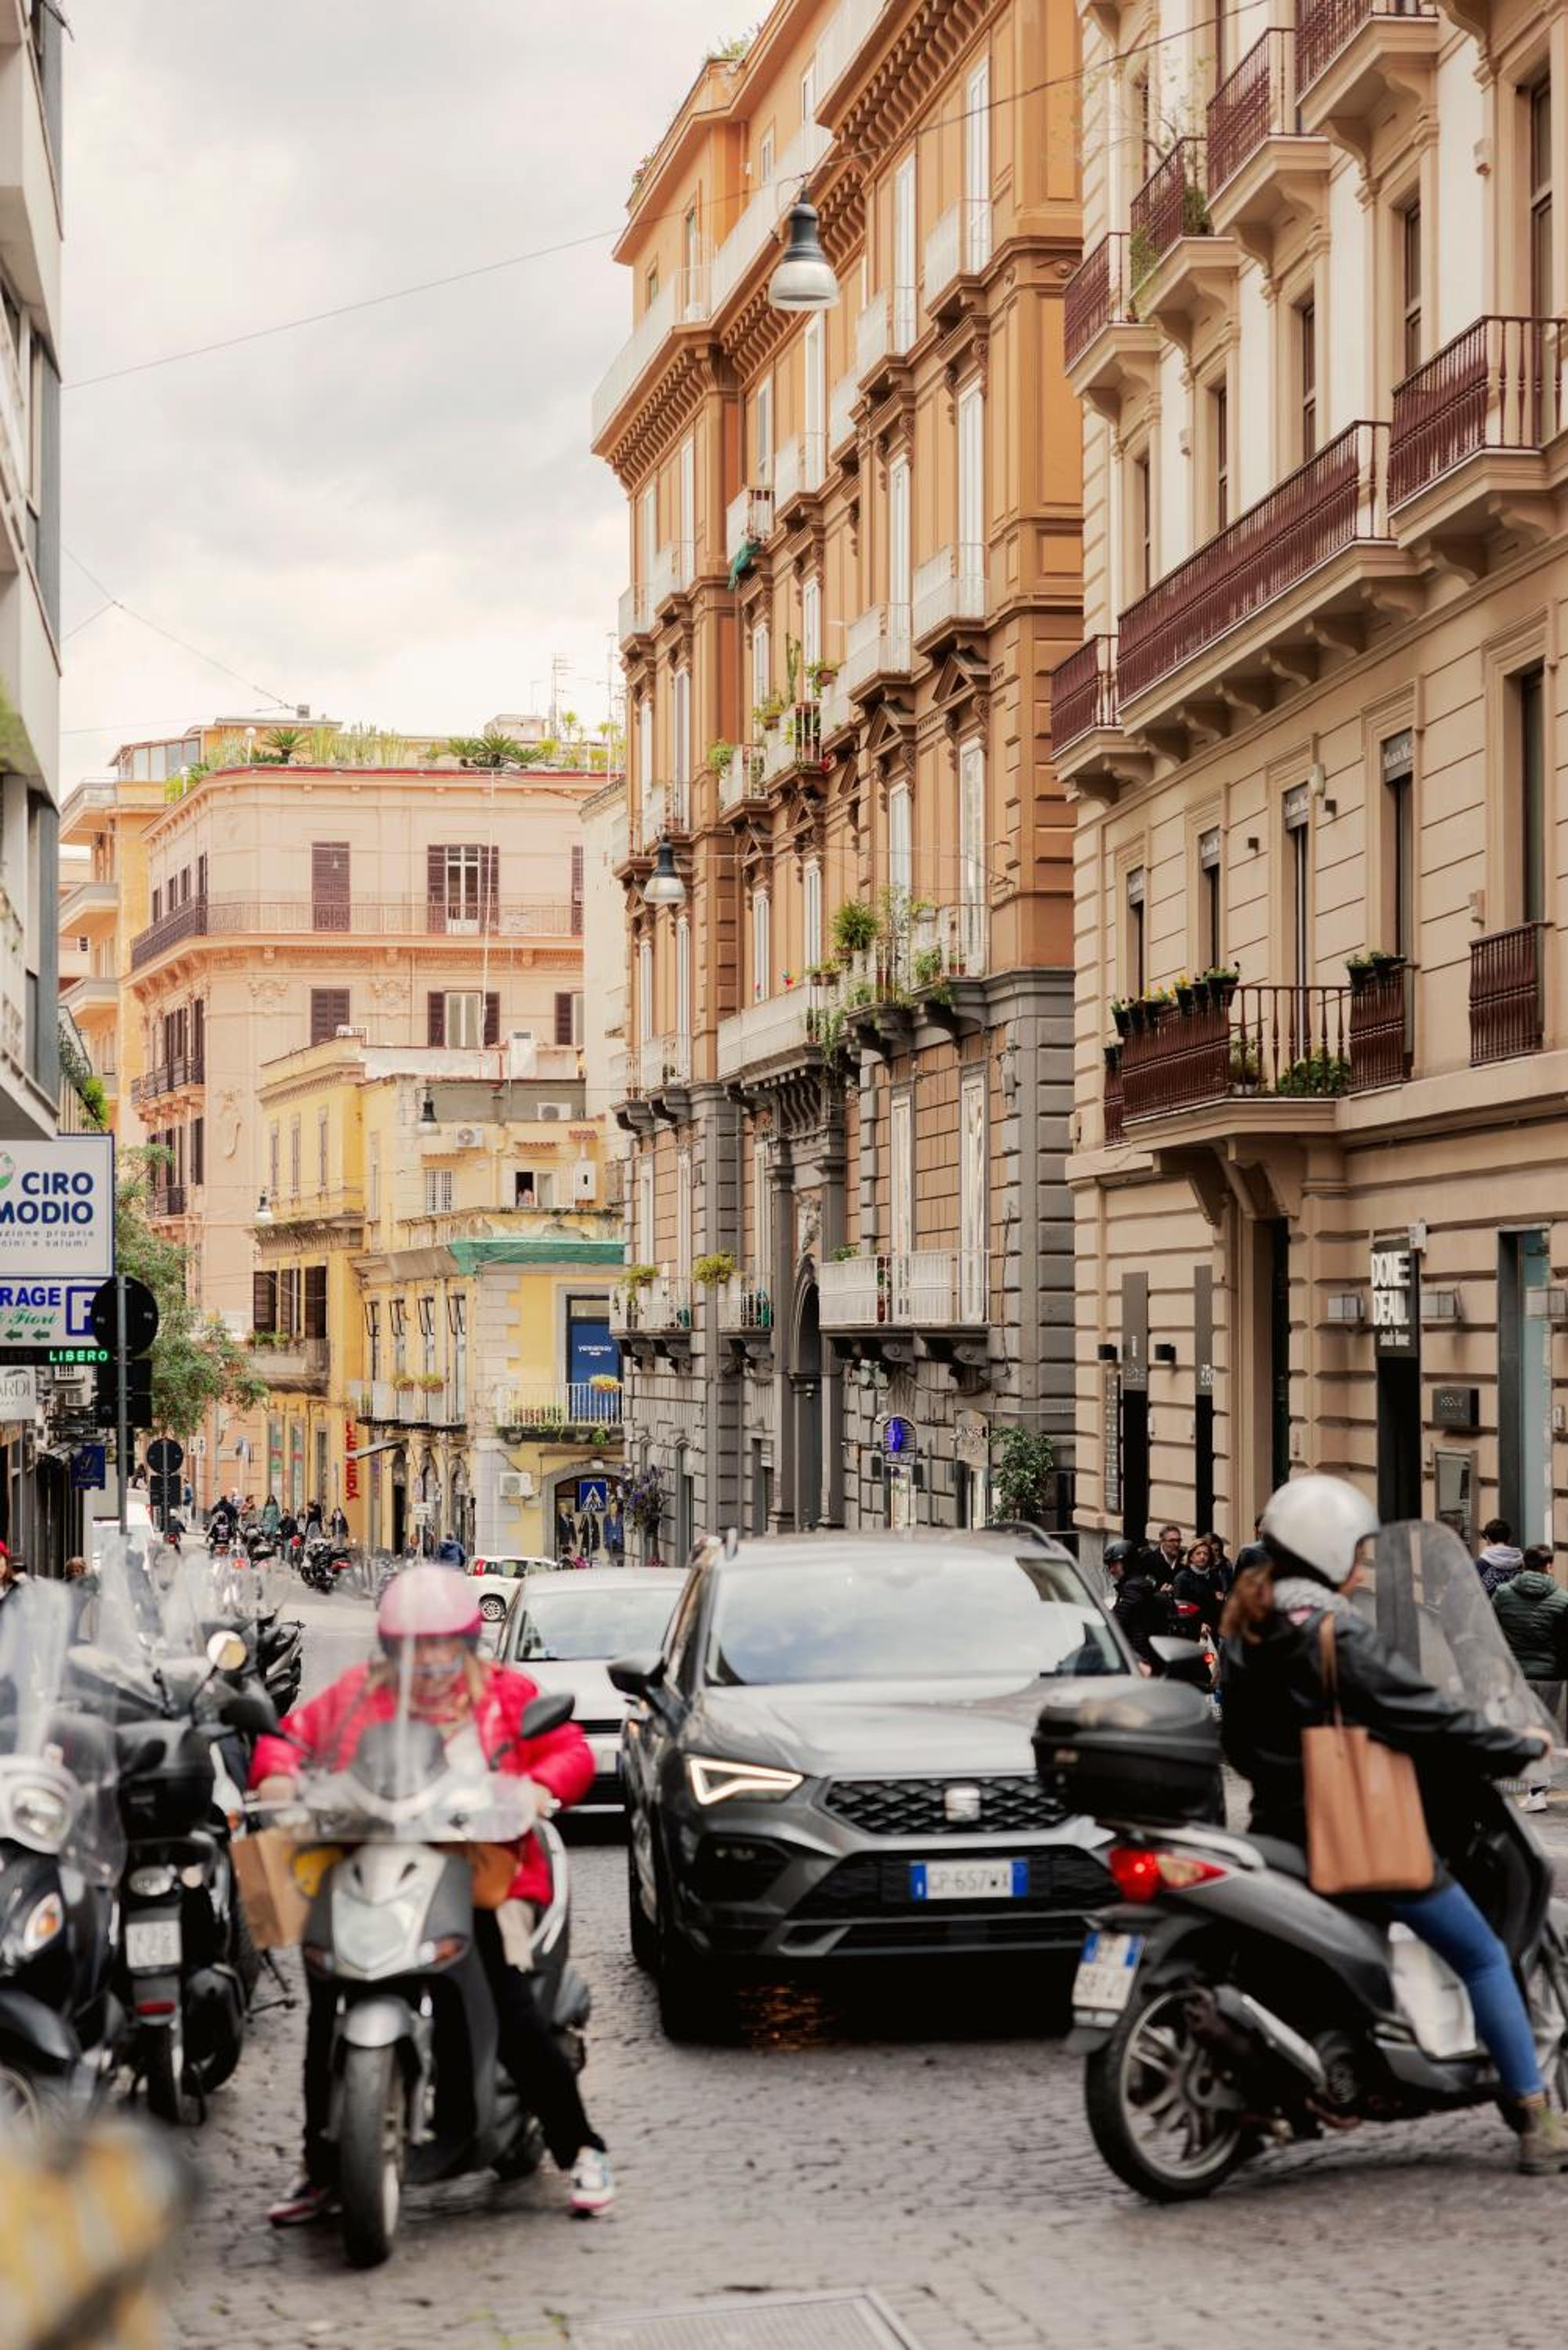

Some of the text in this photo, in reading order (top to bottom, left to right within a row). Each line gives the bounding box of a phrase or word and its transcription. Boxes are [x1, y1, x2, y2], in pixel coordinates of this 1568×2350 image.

[21, 1171, 93, 1195] CIRO
[46, 1230, 95, 1238] propria
[45, 1239, 88, 1248] salumi
[0, 1287, 61, 1307] RAGE
[1373, 1290, 1410, 1325] DEAL
[49, 1350, 109, 1362] LIBERO
